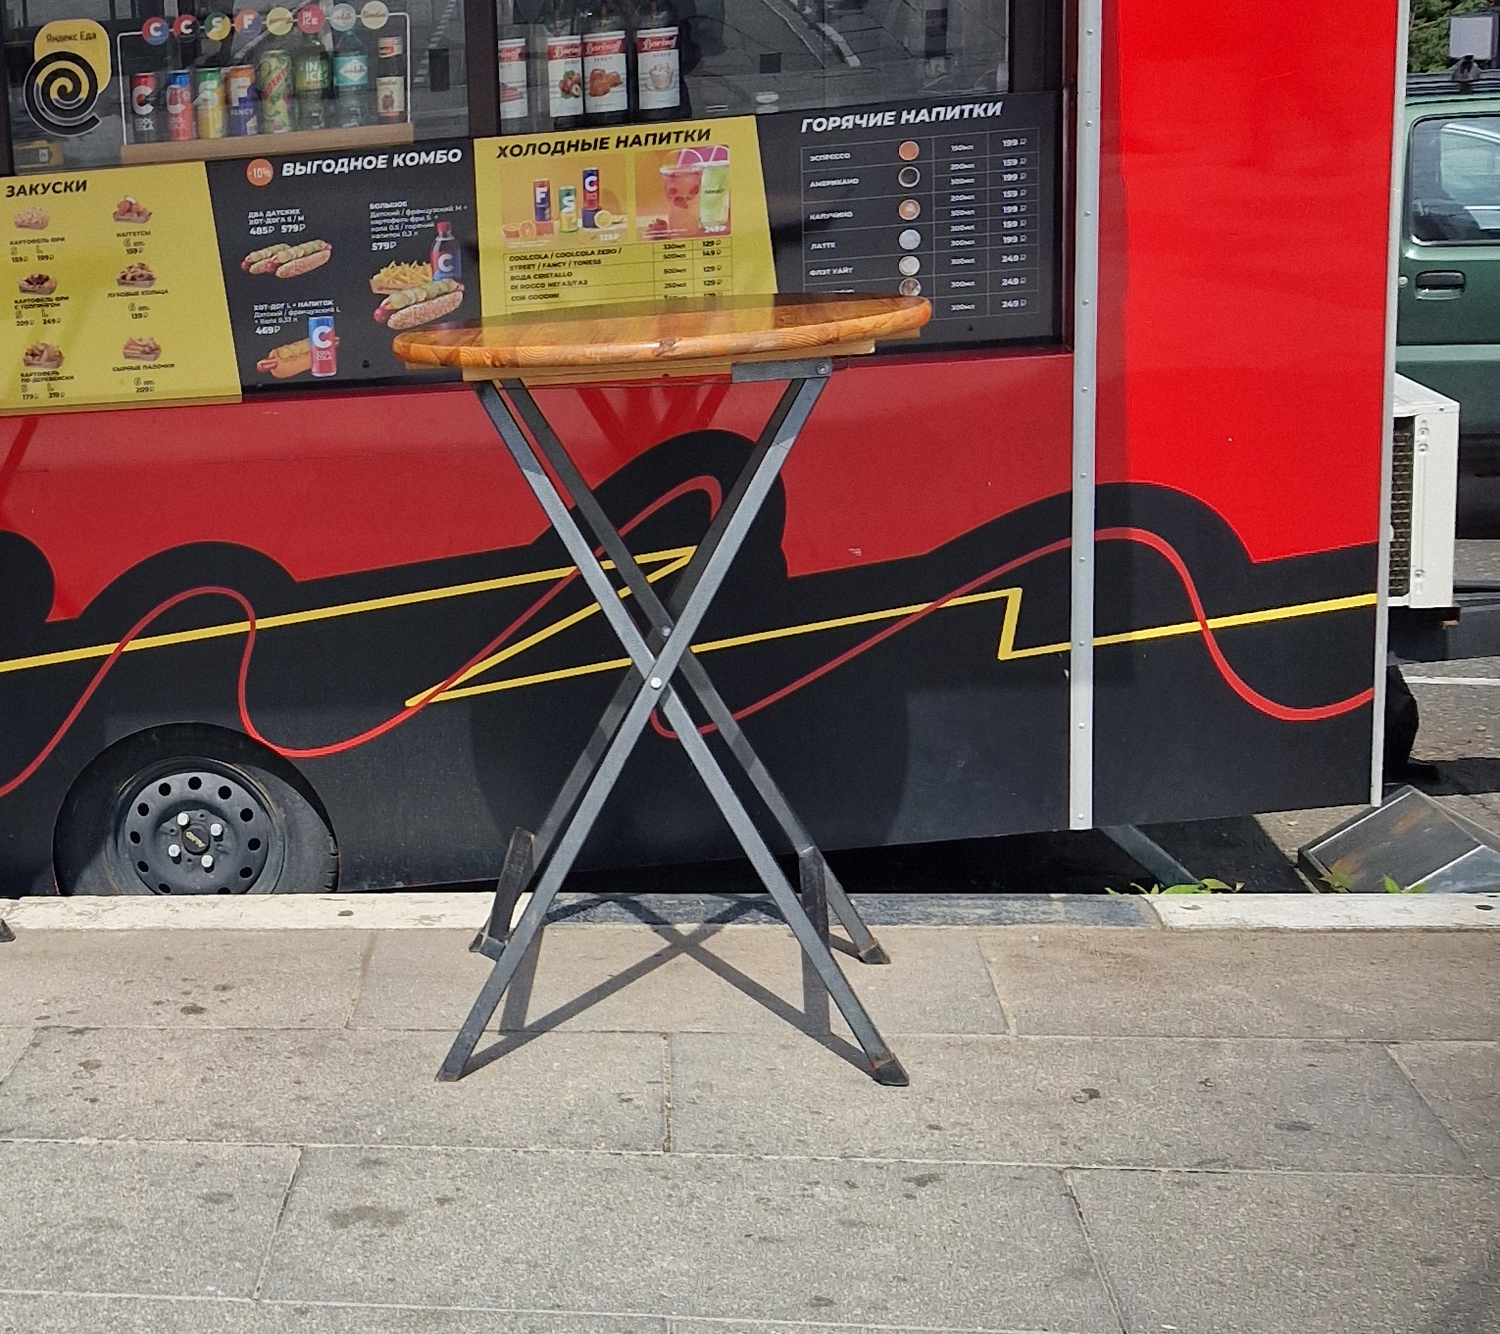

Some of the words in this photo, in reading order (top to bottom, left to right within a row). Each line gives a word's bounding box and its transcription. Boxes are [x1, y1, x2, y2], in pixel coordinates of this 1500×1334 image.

[46, 33, 77, 43] Яндекс
[80, 31, 96, 41] Еда
[800, 111, 897, 134] ГОРЯЧИЕ
[900, 101, 1003, 125] НАПИТКИ
[496, 136, 611, 159] ХОЛОДНЫЕ
[615, 128, 711, 149] НАПИТКИ
[282, 154, 388, 177] ВЫГОДНОЕ
[392, 148, 463, 168] КОМБО
[5, 179, 88, 198] ЗАКУСКИ
[312, 325, 332, 349] C
